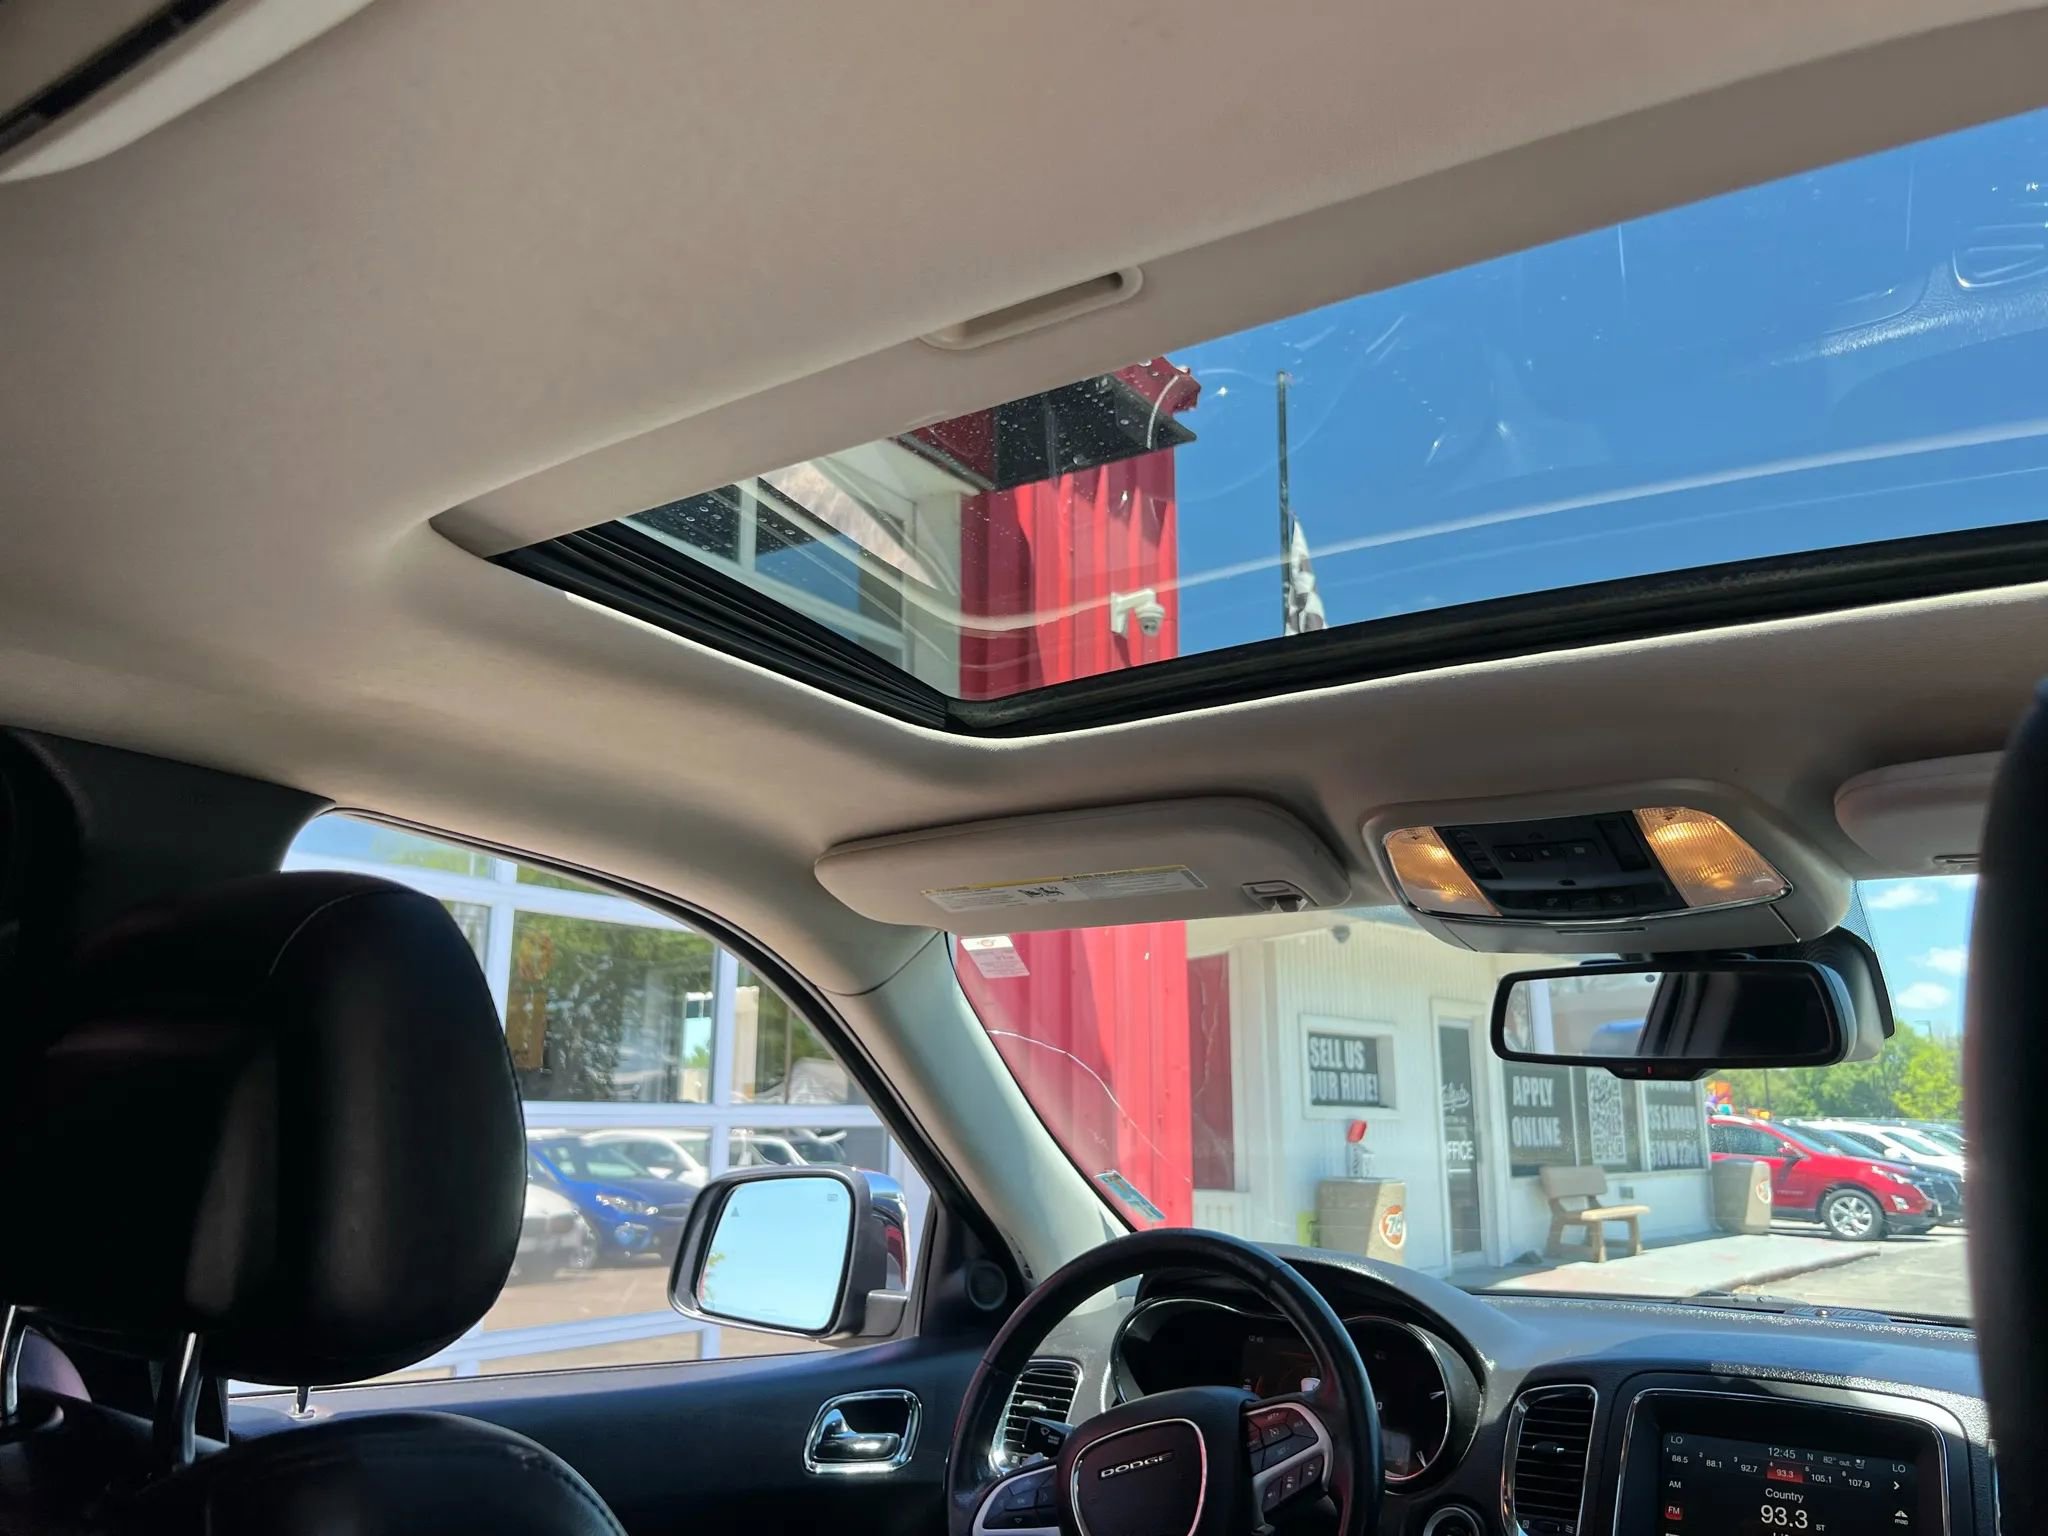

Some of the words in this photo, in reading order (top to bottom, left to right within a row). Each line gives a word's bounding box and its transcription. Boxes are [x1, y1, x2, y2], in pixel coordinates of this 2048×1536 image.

[1310, 1036, 1342, 1068] SELL
[1343, 1039, 1365, 1070] US
[1340, 1071, 1378, 1102] RIDE!
[1512, 1075, 1554, 1107] APPLY
[1511, 1116, 1562, 1147] ONLINE
[1670, 1435, 1683, 1444] LO
[1100, 1451, 1174, 1479] DODGE
[1768, 1447, 1796, 1460] 12:45
[1806, 1453, 1814, 1462] N
[1671, 1454, 1689, 1464] 88.5
[1706, 1459, 1722, 1469] 88.1
[1741, 1464, 1758, 1473] 92.7
[1776, 1468, 1794, 1478] 93.3
[1811, 1473, 1832, 1484] 105.1
[1848, 1478, 1871, 1489] 107.9
[1892, 1463, 1906, 1474] LO
[1669, 1480, 1682, 1489] AM
[1765, 1487, 1804, 1504] Country
[1668, 1505, 1680, 1515] FM
[1760, 1504, 1809, 1529] 93.3
